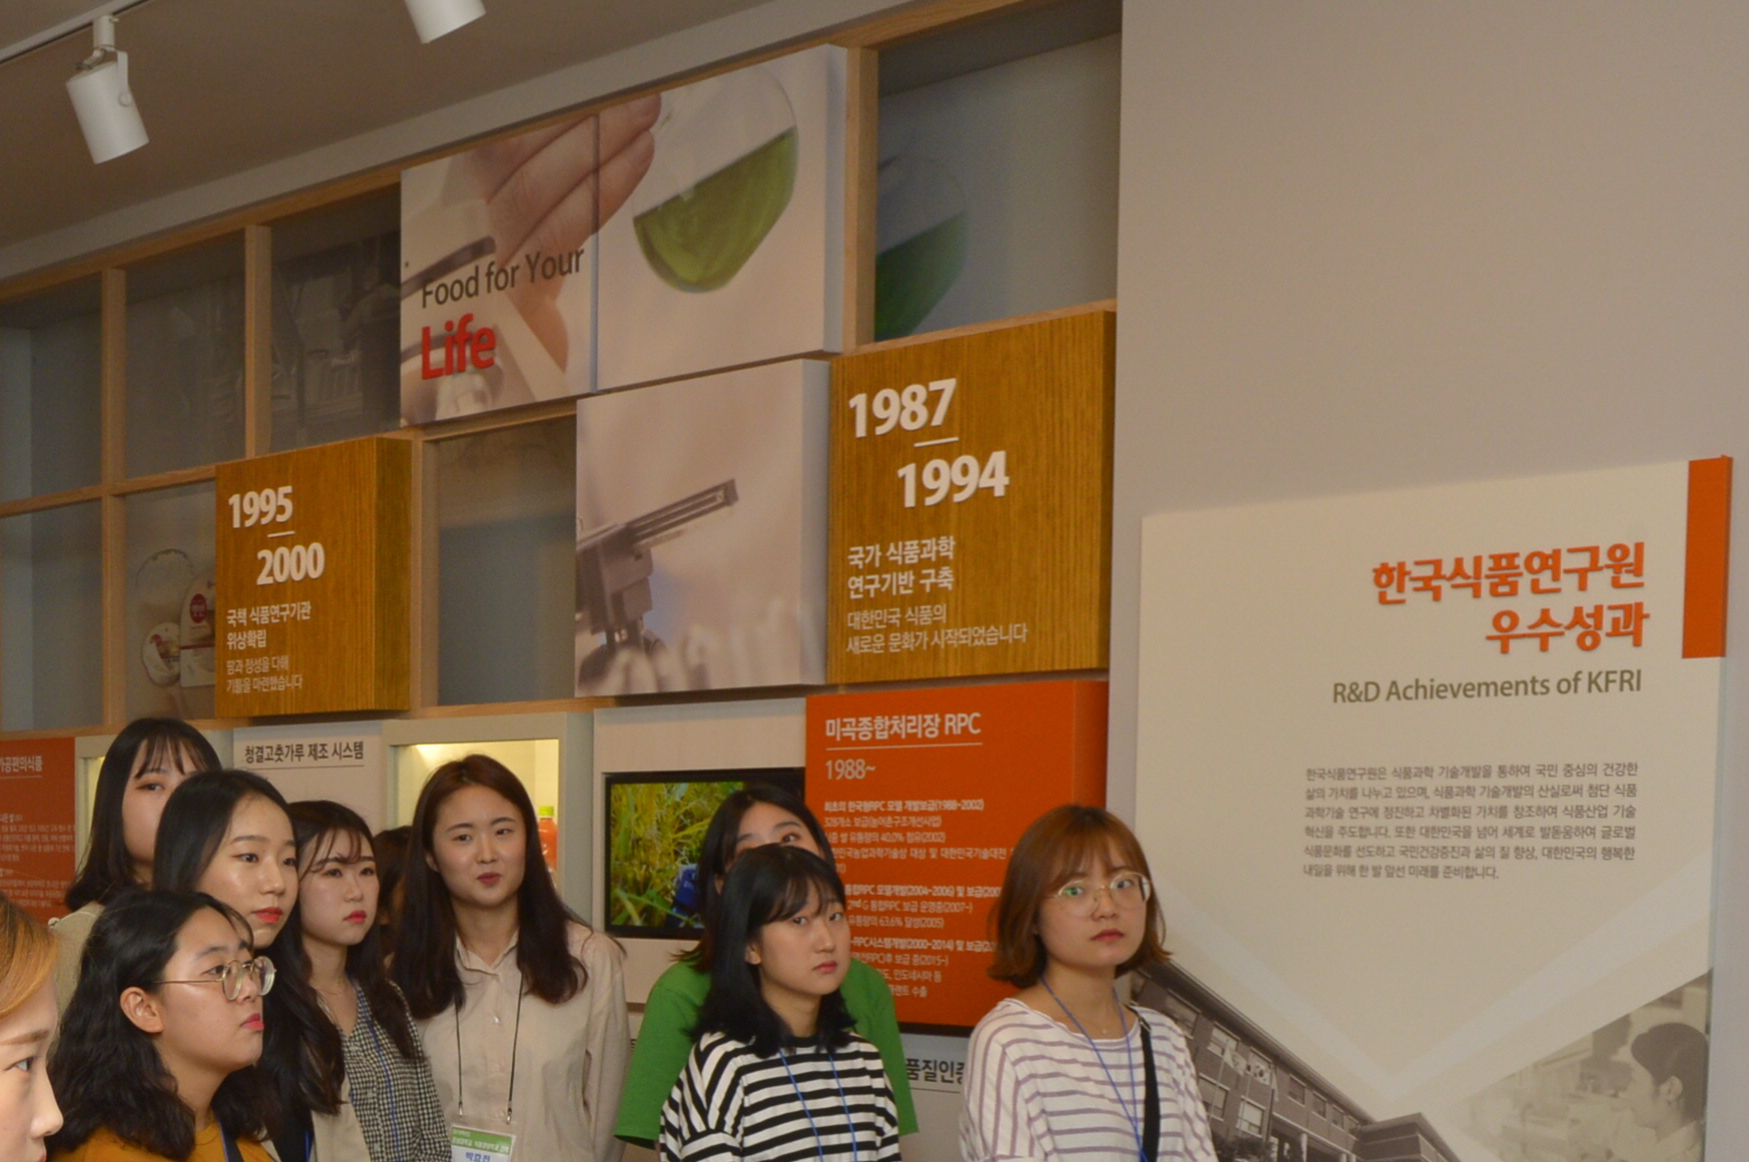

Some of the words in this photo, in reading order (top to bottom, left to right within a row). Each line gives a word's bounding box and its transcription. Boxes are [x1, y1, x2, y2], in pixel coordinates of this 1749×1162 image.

[422, 265, 479, 309] Food
[486, 261, 520, 294] for
[525, 249, 584, 282] Your
[422, 313, 496, 380] Life
[849, 378, 957, 438] 1987
[897, 451, 1010, 508] 1994
[229, 486, 293, 528] 1995
[257, 542, 325, 585] 2000
[848, 544, 881, 570] 국가
[886, 536, 955, 566] 식품과학
[848, 571, 914, 600] 연구기반
[919, 566, 954, 593] 구축
[1372, 541, 1645, 606] 한국식품연구원
[227, 608, 247, 627] 국책
[250, 601, 311, 624] 식품연구기관
[848, 607, 901, 631] 대한민국
[905, 603, 947, 626] 식품의
[1485, 601, 1650, 655] 우수성과
[227, 629, 267, 649] 위상확립
[847, 633, 886, 655] 새로운
[888, 631, 928, 653] 문화가
[931, 623, 1027, 649] 시작되었습니다
[1333, 681, 1380, 704] R&D
[1386, 675, 1550, 701] Achievements
[1556, 671, 1582, 694] of
[1588, 669, 1642, 694] KFRI
[826, 714, 941, 742] 미곡종합처리장
[944, 712, 981, 735] RPC
[245, 744, 304, 764] 청결고춧가루
[308, 743, 328, 760] 제조
[332, 741, 364, 760] 시스템
[825, 758, 876, 780] 1988~
[1306, 767, 1387, 782] 한국식품연구원은
[1392, 766, 1434, 780] 식품과학
[1438, 765, 1492, 779] 기술개발을
[1497, 764, 1531, 779] 통하여
[1536, 764, 1558, 778] 국민
[1562, 763, 1598, 778] 중심의
[1603, 762, 1638, 777] 건강한
[1306, 787, 1326, 801] 삶의
[1328, 787, 1358, 800] 가치를
[1362, 787, 1393, 800] 나누고
[1434, 785, 1476, 799] 식품과학
[1480, 785, 1535, 799] 기술개발의
[1537, 784, 1584, 798] 산실로써
[1587, 784, 1610, 798] 첨단
[1614, 783, 1638, 798] 식품
[1304, 806, 1345, 820] 과학기술
[1349, 806, 1379, 820] 연구에
[1384, 806, 1425, 820] 정진하고
[1429, 806, 1472, 820] 차별화된
[1476, 805, 1509, 819] 가치를
[1514, 805, 1558, 819] 창조하여
[1562, 805, 1608, 819] 식품산업
[1613, 805, 1637, 819] 기술
[1338, 825, 1391, 839] 주도합니다.
[1394, 825, 1415, 839] 또한
[1419, 825, 1472, 839] 대한민국을
[1476, 825, 1498, 839] 넘어
[1502, 825, 1535, 839] 세계로
[1601, 825, 1636, 839] 글로벌
[1304, 845, 1352, 858] 식품문화를
[1356, 845, 1395, 858] 선도하고
[1400, 845, 1470, 859] 국민건강증진과
[1474, 846, 1495, 859] 삶의
[1500, 846, 1510, 859] 질
[1542, 846, 1597, 860] 대한민국의
[1601, 846, 1635, 861] 행복한
[1336, 864, 1356, 877] 위해
[1408, 865, 1439, 878] 미래를
